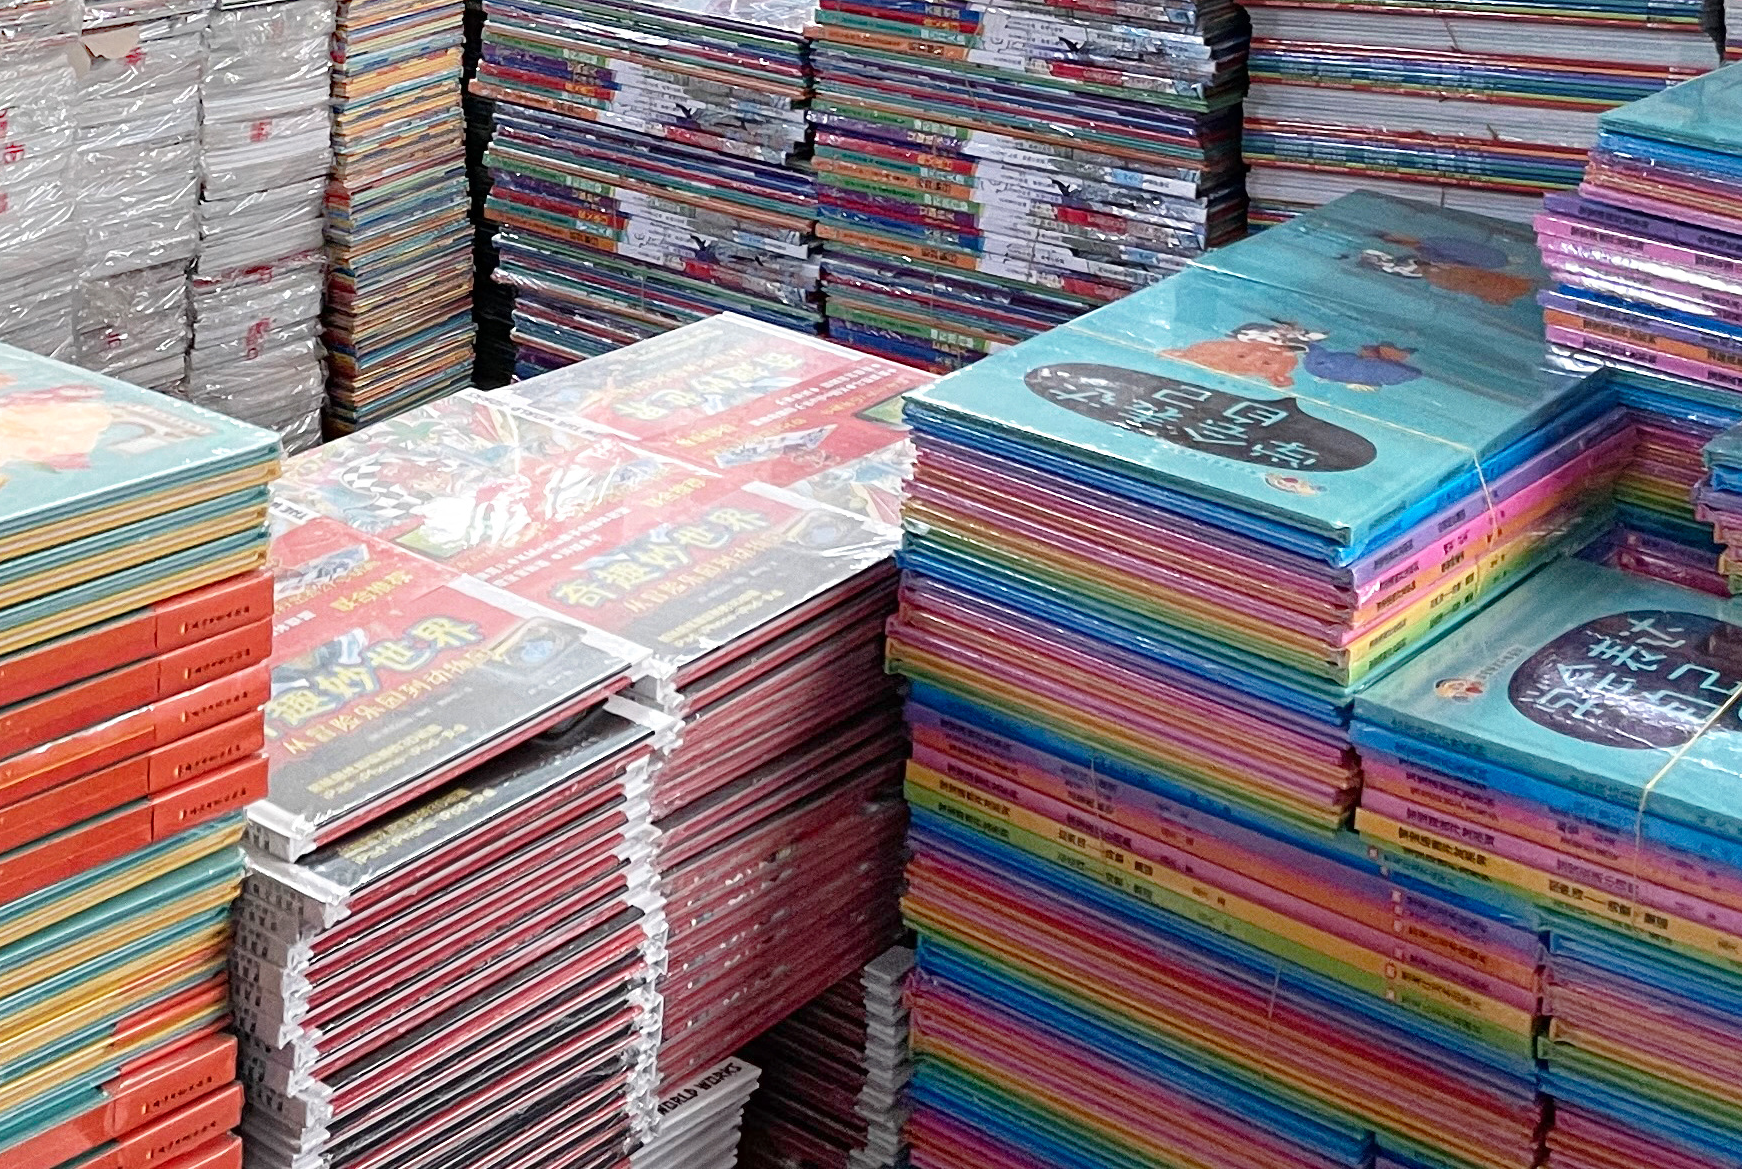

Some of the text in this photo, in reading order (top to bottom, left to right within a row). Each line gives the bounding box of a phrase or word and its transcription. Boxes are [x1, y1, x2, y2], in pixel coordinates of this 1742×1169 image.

[1151, 384, 1288, 427] 自己
[552, 509, 770, 609] 奇趣妙世界
[265, 615, 484, 737] 趣妙世界
